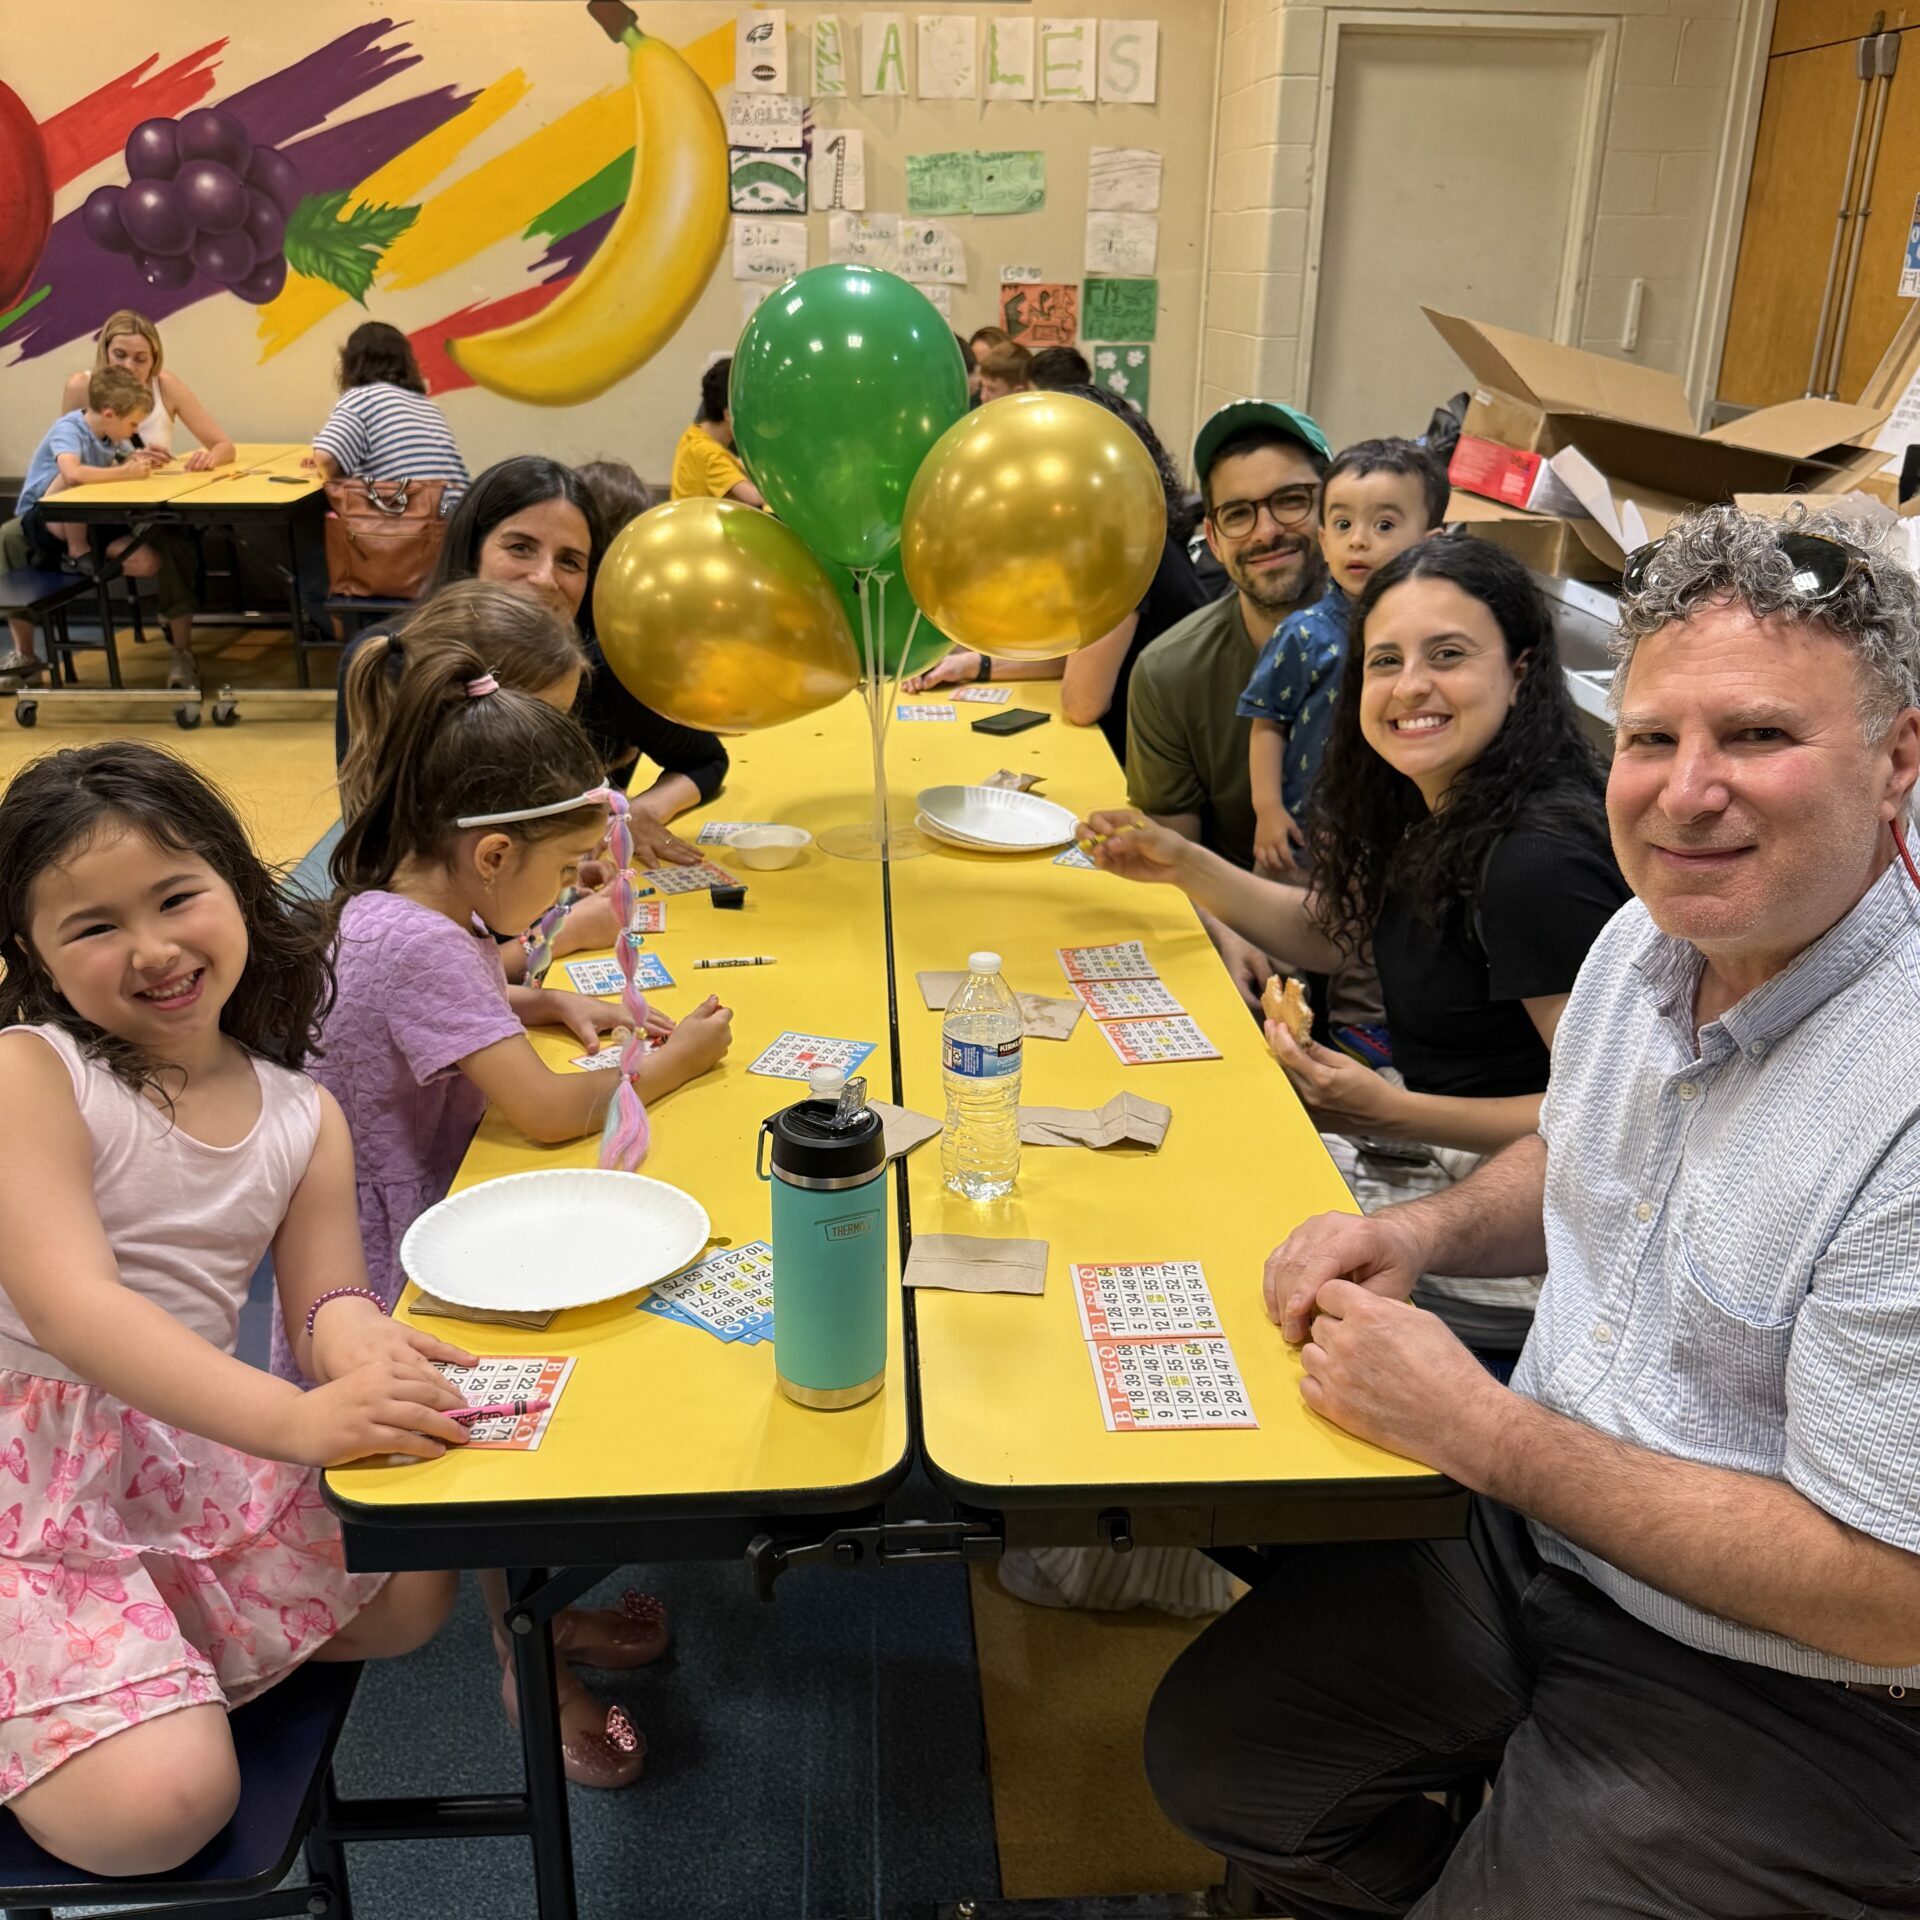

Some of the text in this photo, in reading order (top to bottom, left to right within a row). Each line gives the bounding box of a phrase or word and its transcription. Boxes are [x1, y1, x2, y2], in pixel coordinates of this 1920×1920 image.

[825, 136, 846, 208] 1
[663, 1245, 764, 1290] 10 23 31 53 75
[741, 1263, 757, 1272] 17
[1119, 1267, 1134, 1276] 68
[1140, 1266, 1154, 1276] 75
[1161, 1265, 1177, 1276] 72
[718, 1272, 735, 1282] 44
[690, 1270, 771, 1308] 24 52 71
[699, 1280, 716, 1292] 57
[1122, 1280, 1137, 1290] 48
[1143, 1280, 1159, 1290] 55
[1165, 1279, 1181, 1289] 52
[675, 1289, 695, 1299] 64
[744, 1289, 762, 1298] 45
[1126, 1293, 1141, 1303] 34
[1169, 1293, 1185, 1304] 37
[1184, 1265, 1217, 1329] 14 30 41 54 73
[723, 1297, 743, 1307] 58
[1080, 1268, 1109, 1333] BINGO
[1097, 1268, 1125, 1331] 11 28 45 58 64
[701, 1307, 723, 1317] 73
[736, 1305, 754, 1316] 48
[1130, 1307, 1145, 1316] 19
[1153, 1308, 1167, 1318] 21
[1174, 1306, 1188, 1316] 16
[715, 1314, 735, 1326] 69
[1156, 1321, 1170, 1331] 12
[1141, 1344, 1154, 1355] 72
[1164, 1344, 1179, 1355] 74
[1187, 1343, 1202, 1355] 64
[1209, 1343, 1224, 1354] 75
[525, 1364, 543, 1374] 13
[1145, 1359, 1159, 1371] 48
[1167, 1359, 1184, 1371] 55
[1192, 1358, 1208, 1370] 56
[1214, 1359, 1229, 1370] 47
[469, 1379, 488, 1391] 29
[494, 1380, 511, 1390] 18
[517, 1378, 536, 1389] 22
[1100, 1347, 1131, 1422] BINGO
[1118, 1344, 1149, 1420] 14 18 39 54 68
[1150, 1374, 1164, 1387] 40
[1197, 1375, 1212, 1387] 31
[1220, 1374, 1234, 1387] 44
[1154, 1391, 1170, 1403] 28
[1178, 1390, 1194, 1403] 30
[1202, 1390, 1217, 1403] 26
[1226, 1391, 1242, 1403] 29
[1183, 1409, 1199, 1420] 11
[470, 1428, 486, 1440] 61
[492, 1428, 512, 1440] 71
